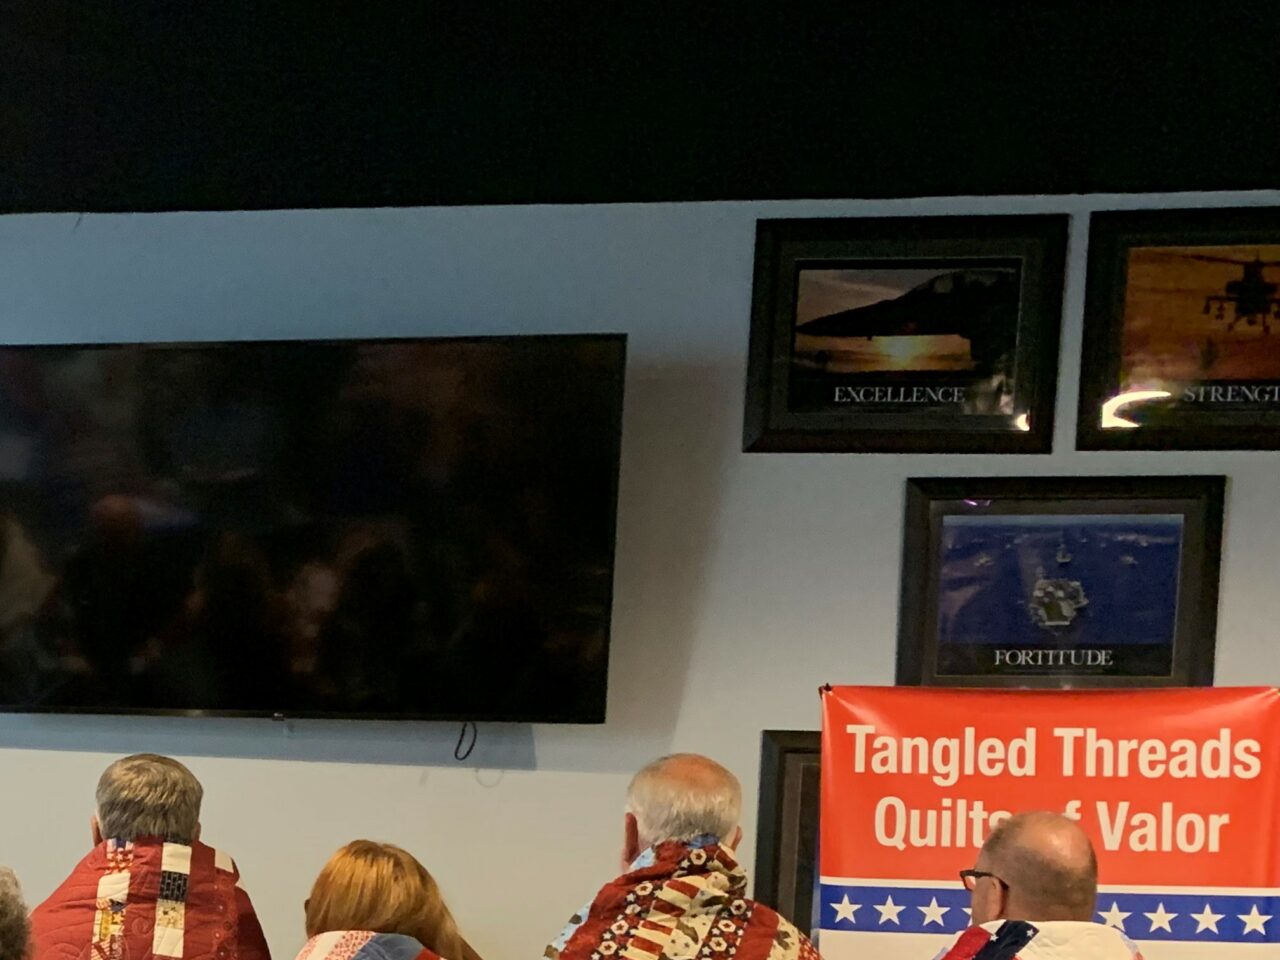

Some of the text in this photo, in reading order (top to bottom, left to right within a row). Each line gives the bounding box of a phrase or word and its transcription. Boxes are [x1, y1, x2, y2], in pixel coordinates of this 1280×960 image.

[833, 386, 966, 403] EXCELLENCE
[1183, 385, 1280, 403] STRENGT
[994, 649, 1114, 666] FORTITUDE
[846, 724, 1262, 787] Tangled Threads
[1096, 801, 1230, 853] Valor
